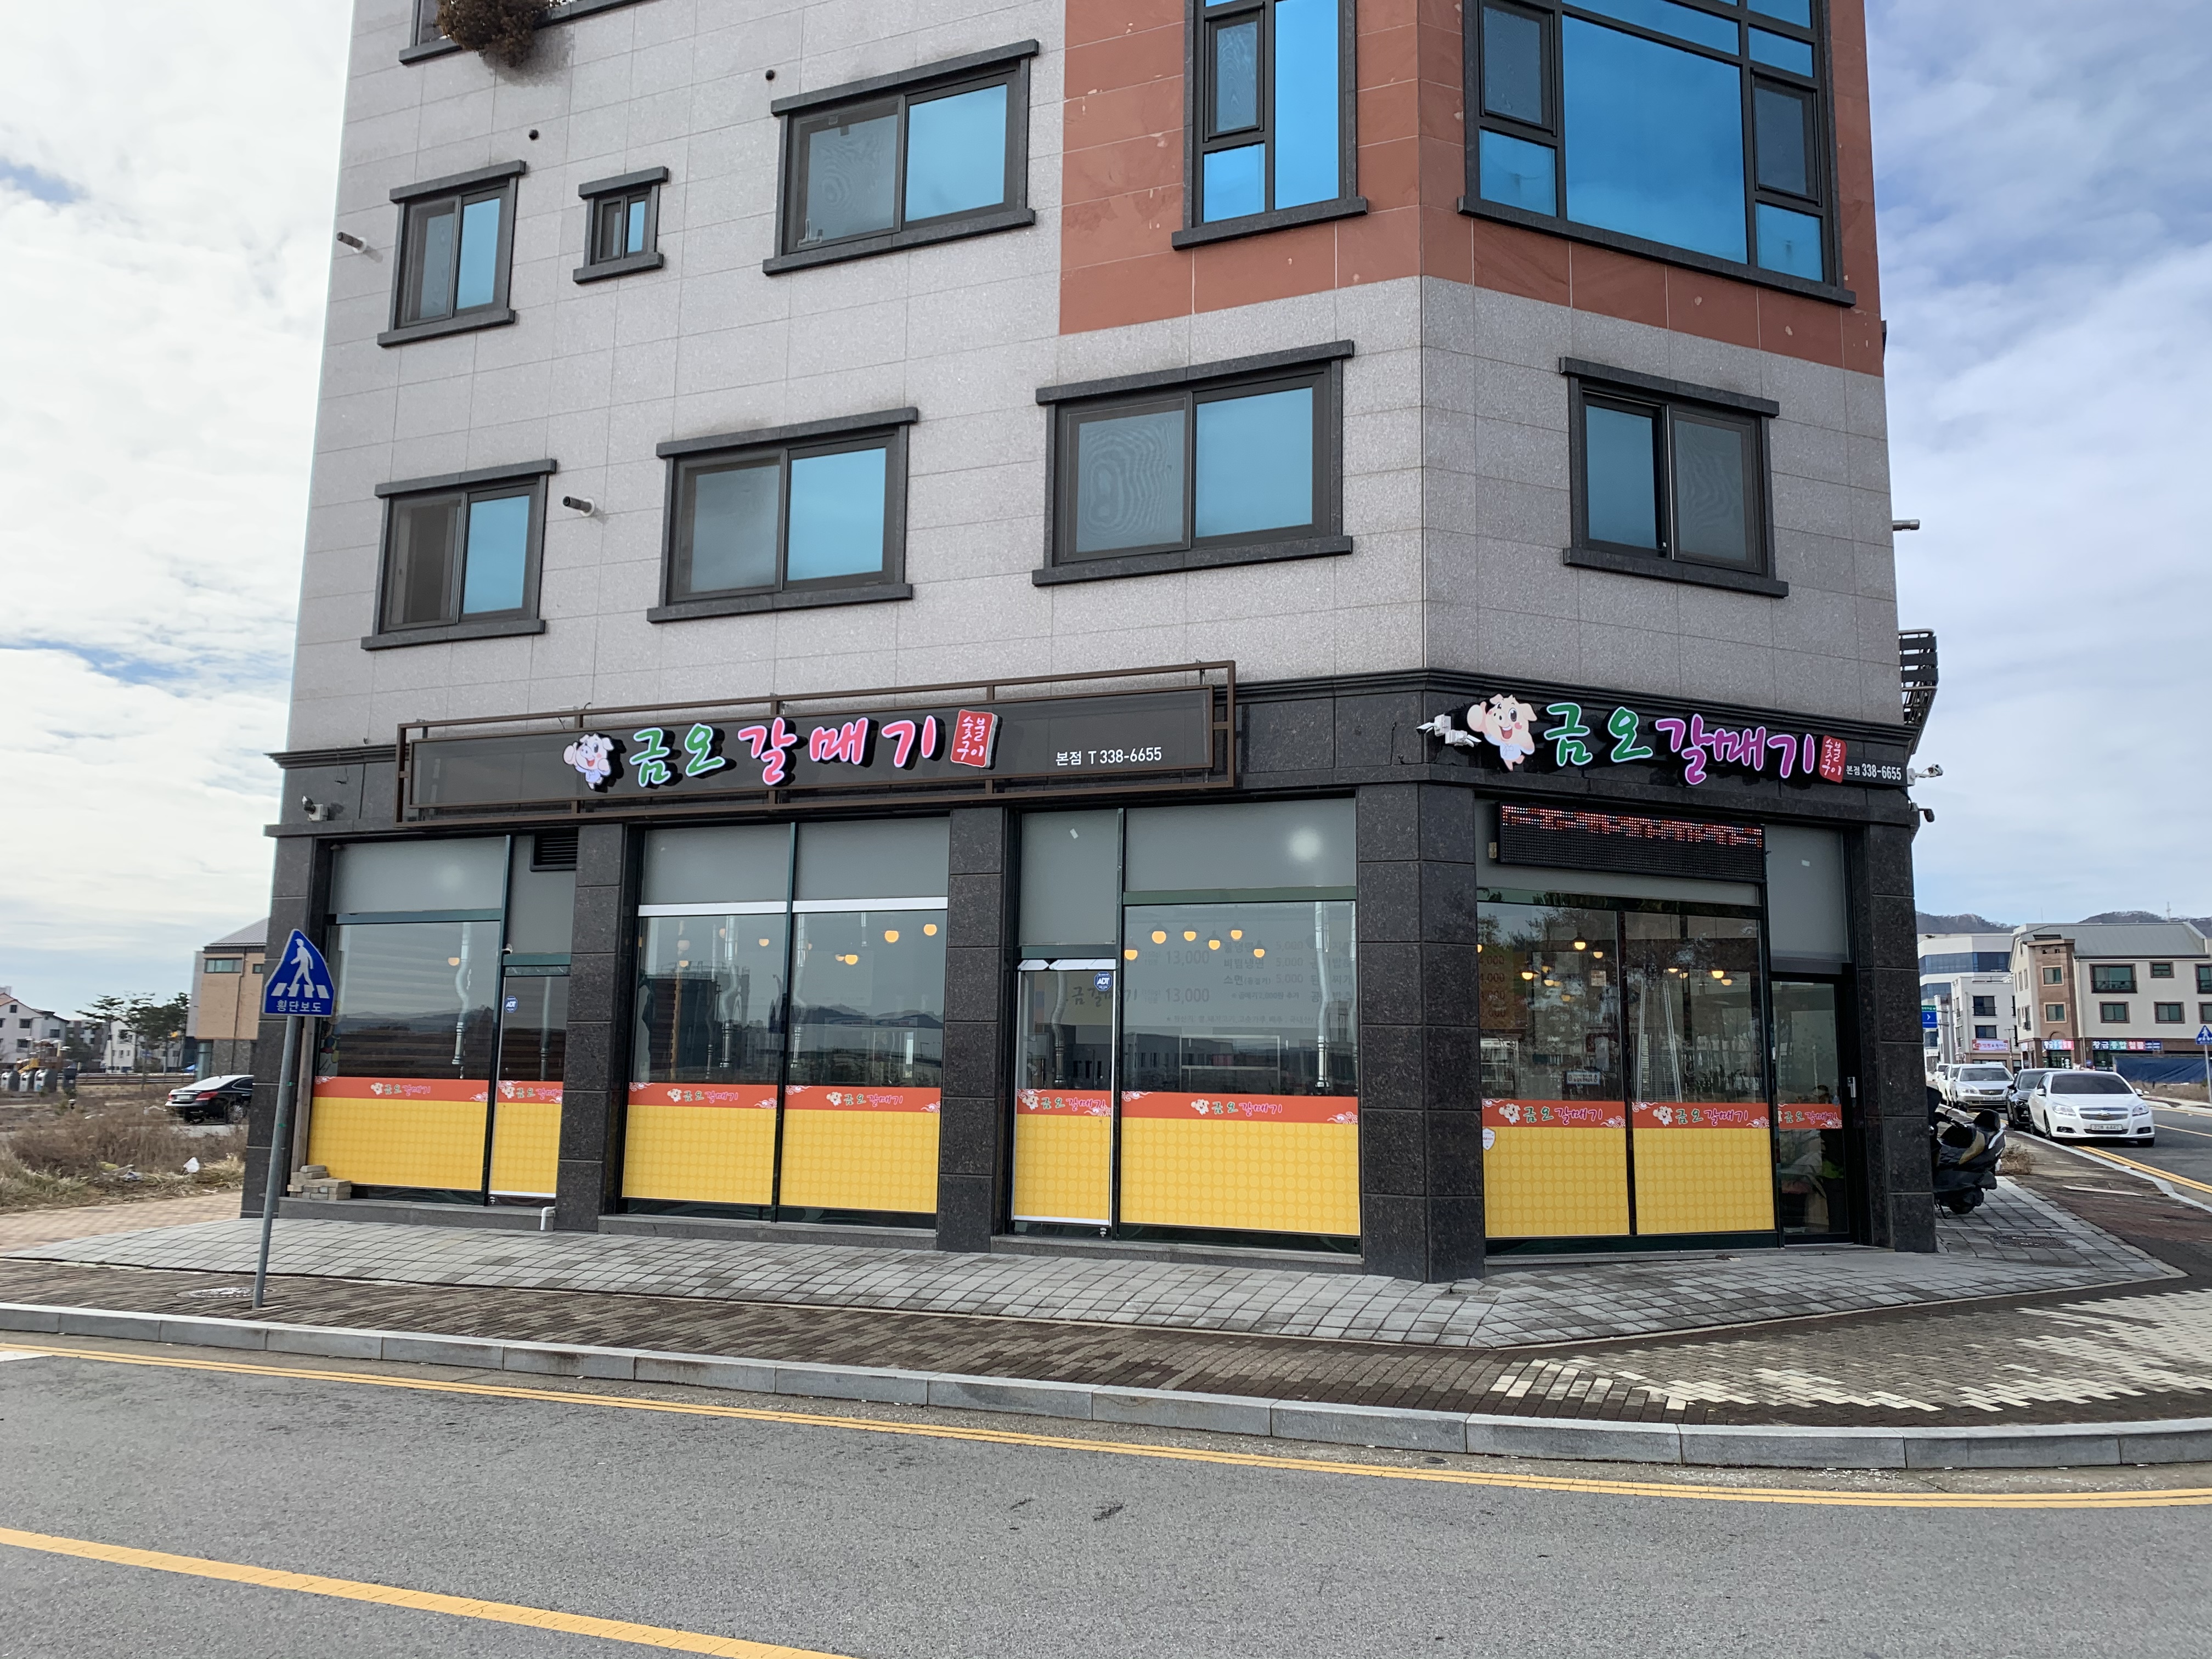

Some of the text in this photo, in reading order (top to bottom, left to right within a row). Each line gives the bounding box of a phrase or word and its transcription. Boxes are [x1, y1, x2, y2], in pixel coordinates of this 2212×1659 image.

[961, 715, 986, 742] 숯불
[956, 741, 985, 761] 구이
[1055, 751, 1082, 766] 본점
[1099, 747, 1162, 764] 338-6655
[1821, 759, 1842, 776] 구이
[1846, 763, 1902, 781] 본점 338-6655
[1166, 950, 1210, 966] 13,000
[1276, 957, 1304, 967] 5,000
[1276, 974, 1304, 984] 5,000
[1166, 988, 1210, 1005] 13,000
[276, 1000, 322, 1013] 횡단보도
